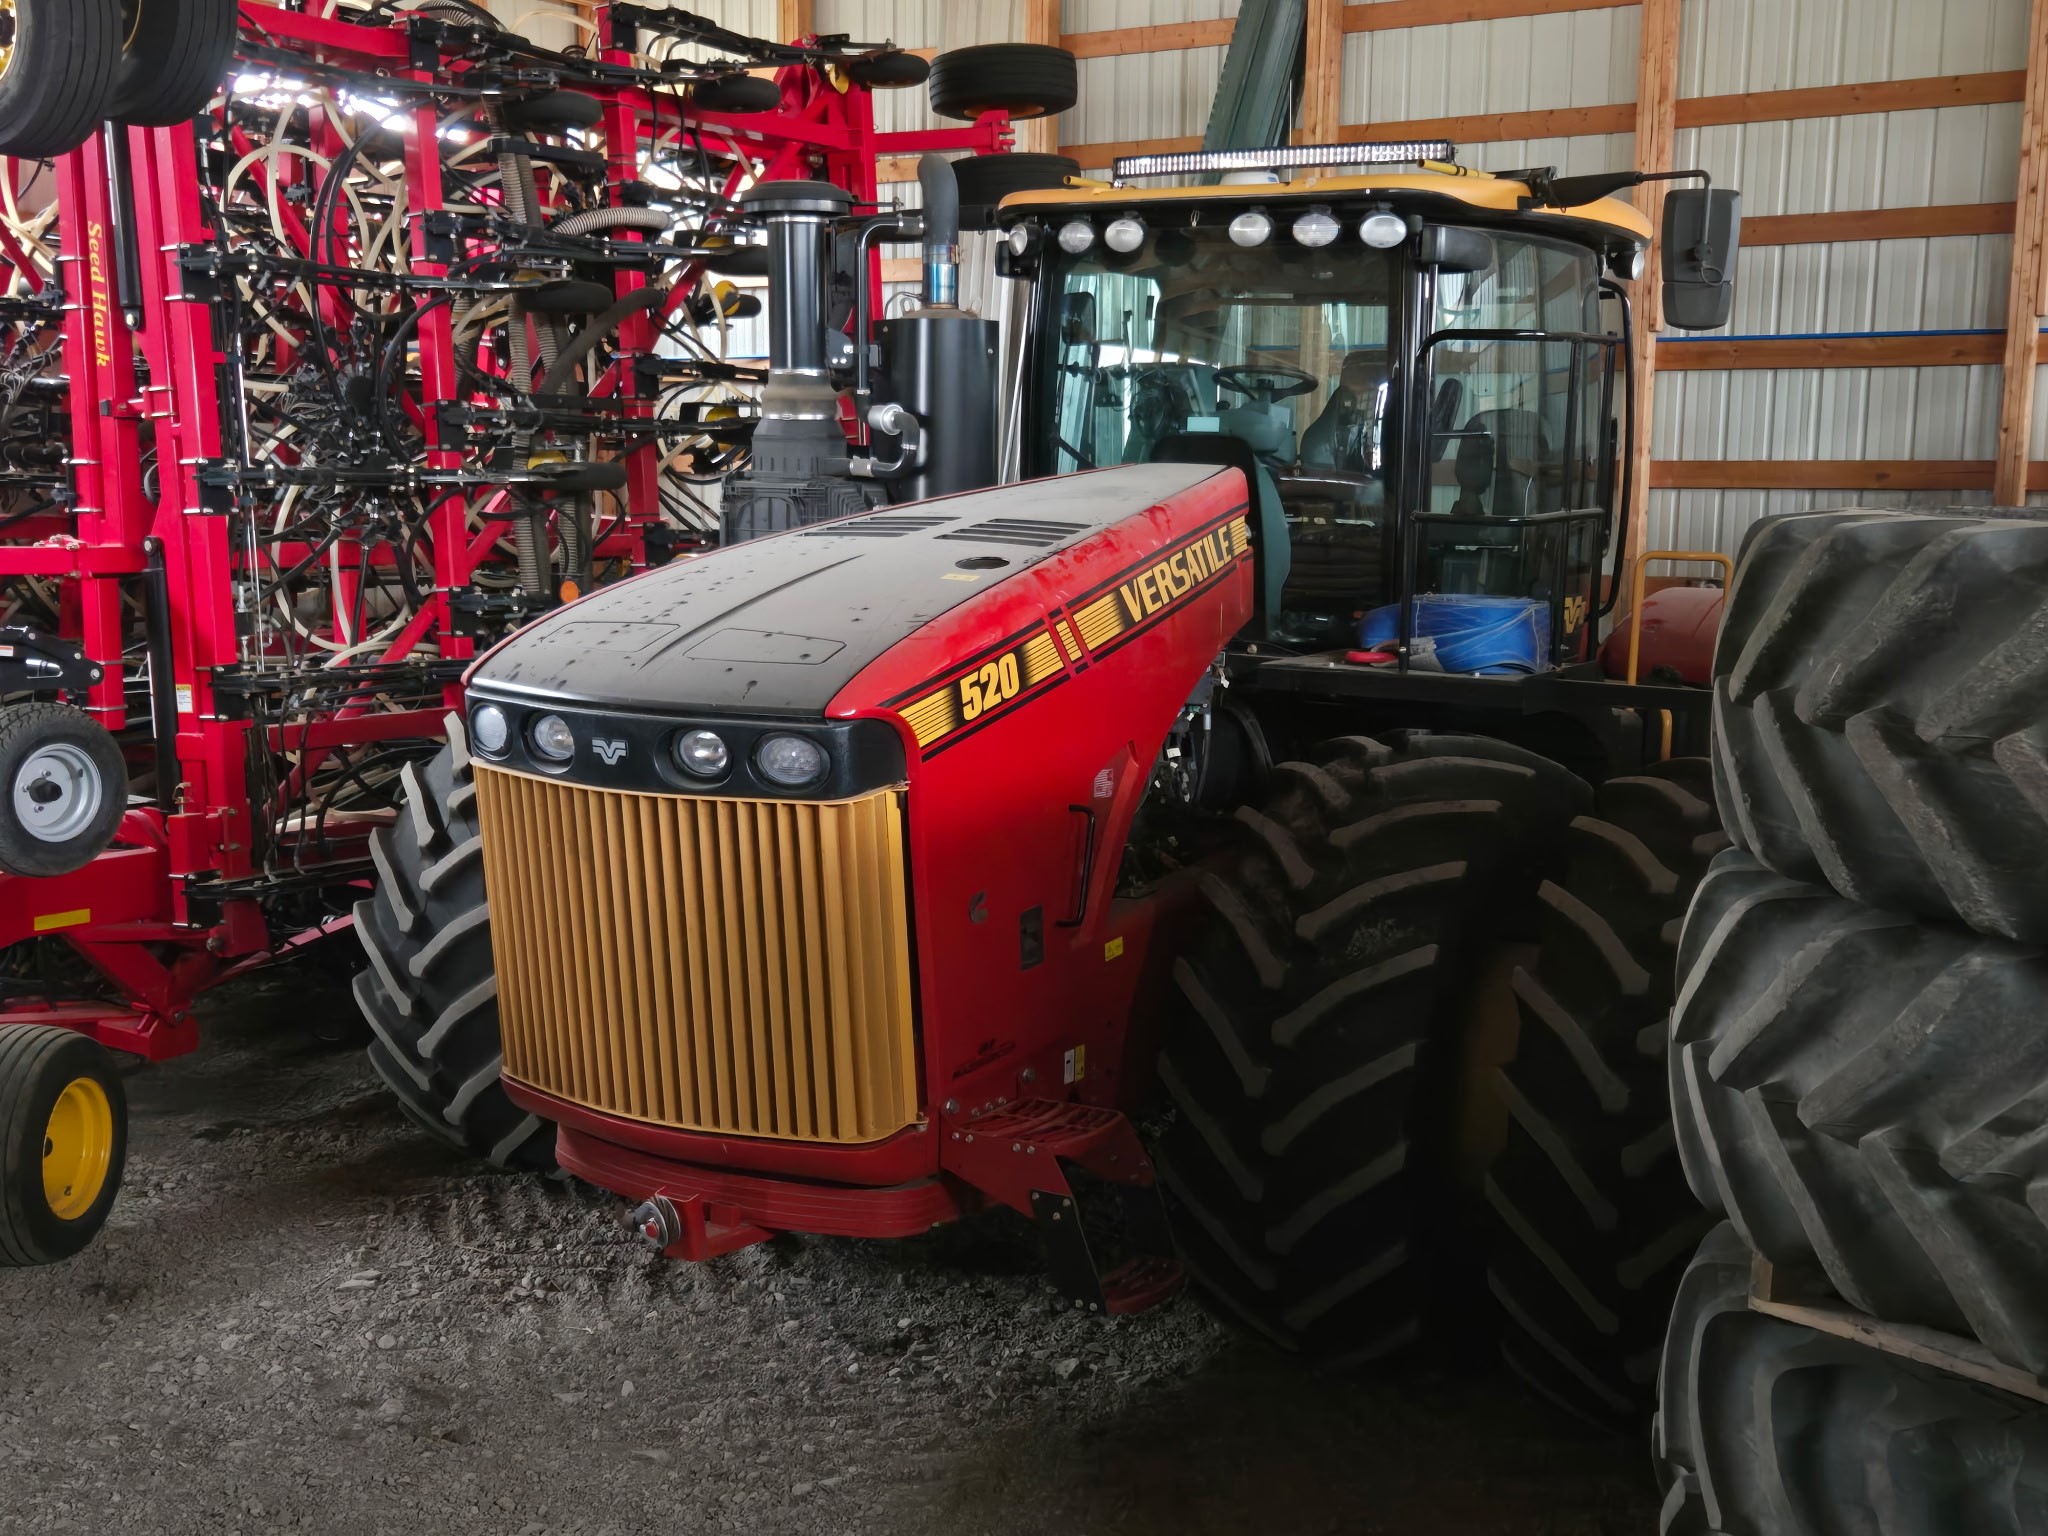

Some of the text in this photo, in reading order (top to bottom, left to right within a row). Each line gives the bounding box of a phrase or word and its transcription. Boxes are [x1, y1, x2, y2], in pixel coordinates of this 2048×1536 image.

[88, 220, 110, 367] Seed Hawk
[1119, 525, 1232, 623] VERSATILE
[959, 652, 1020, 721] 520
